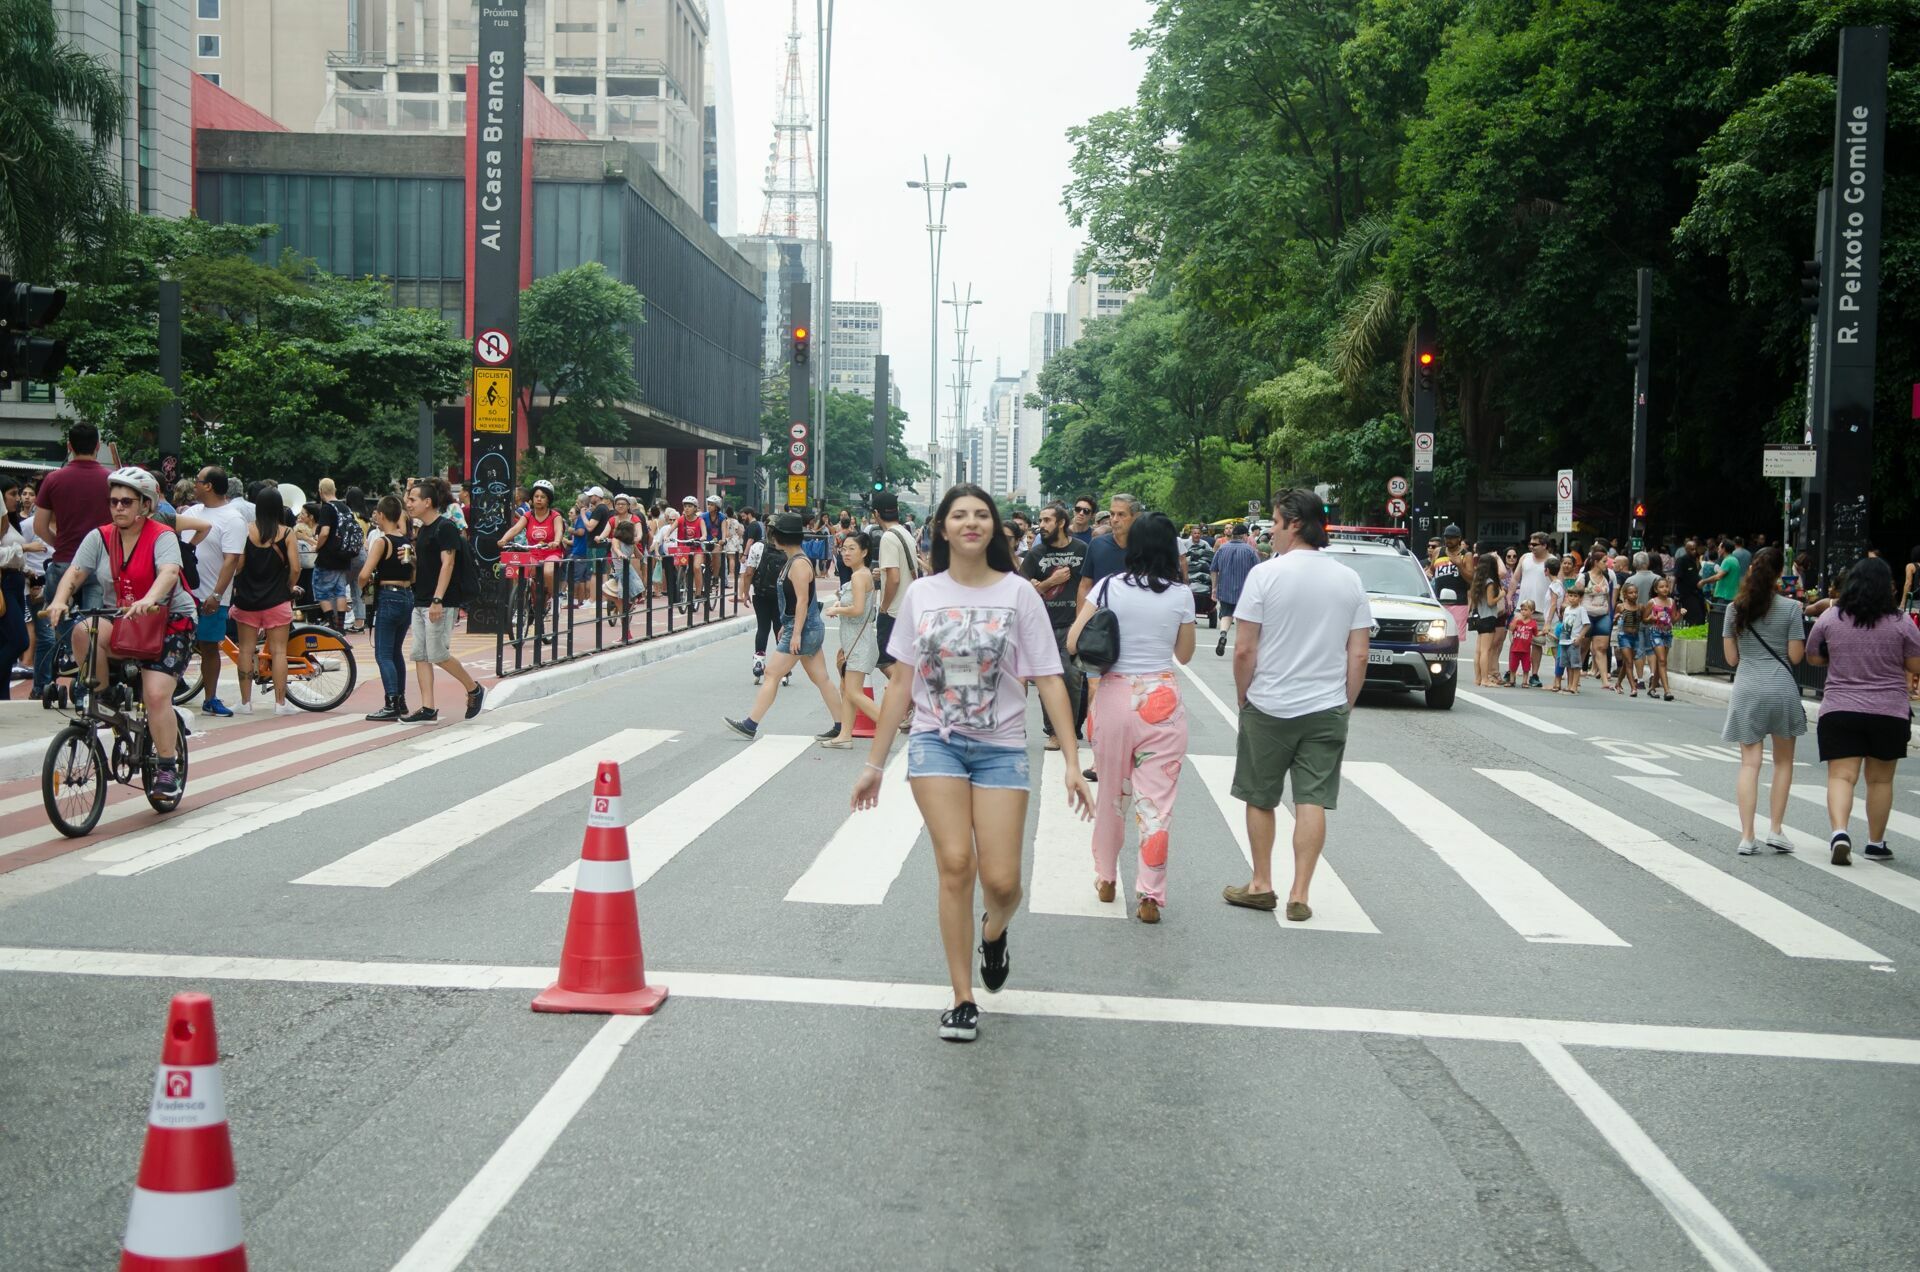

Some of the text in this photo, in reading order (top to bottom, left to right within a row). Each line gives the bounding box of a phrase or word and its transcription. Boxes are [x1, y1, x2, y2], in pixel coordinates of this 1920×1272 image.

[483, 8, 518, 17] Próxima
[493, 19, 509, 27] rua
[481, 50, 505, 251] Al. Casa Branca
[1837, 105, 1869, 344] R. Peixoto Gomide
[1391, 480, 1405, 490] 50
[1370, 654, 1391, 662] 0314
